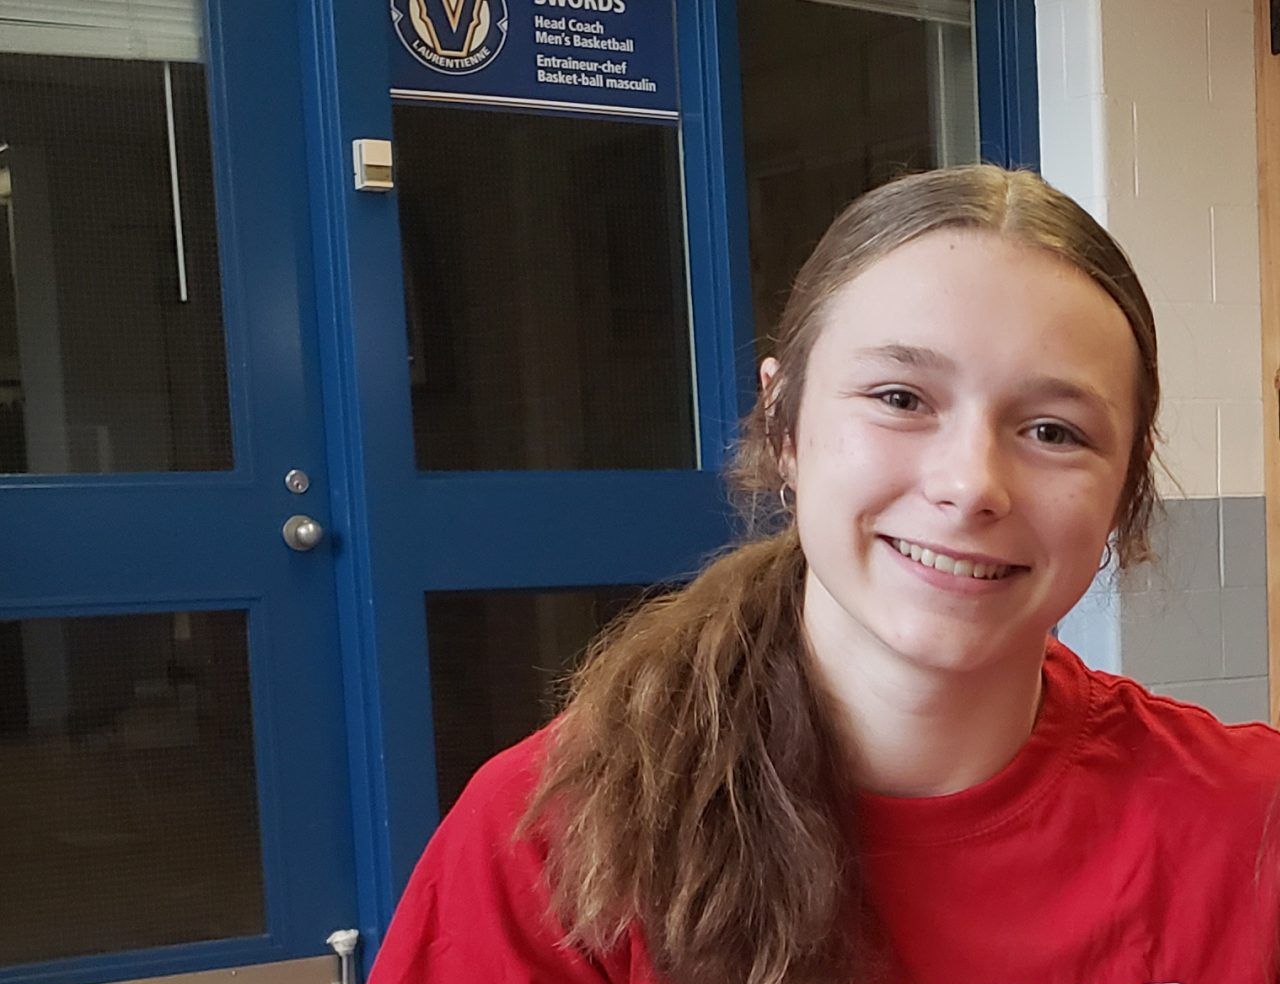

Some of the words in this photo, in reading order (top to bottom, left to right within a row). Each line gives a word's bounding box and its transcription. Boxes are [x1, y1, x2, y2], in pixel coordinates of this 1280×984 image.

[533, 0, 627, 14] RDS
[534, 15, 566, 30] Head
[568, 19, 604, 34] Coach
[535, 31, 571, 46] Men's
[573, 34, 634, 52] Basketball
[537, 69, 604, 87] Basket-ball
[606, 78, 657, 92] masculin
